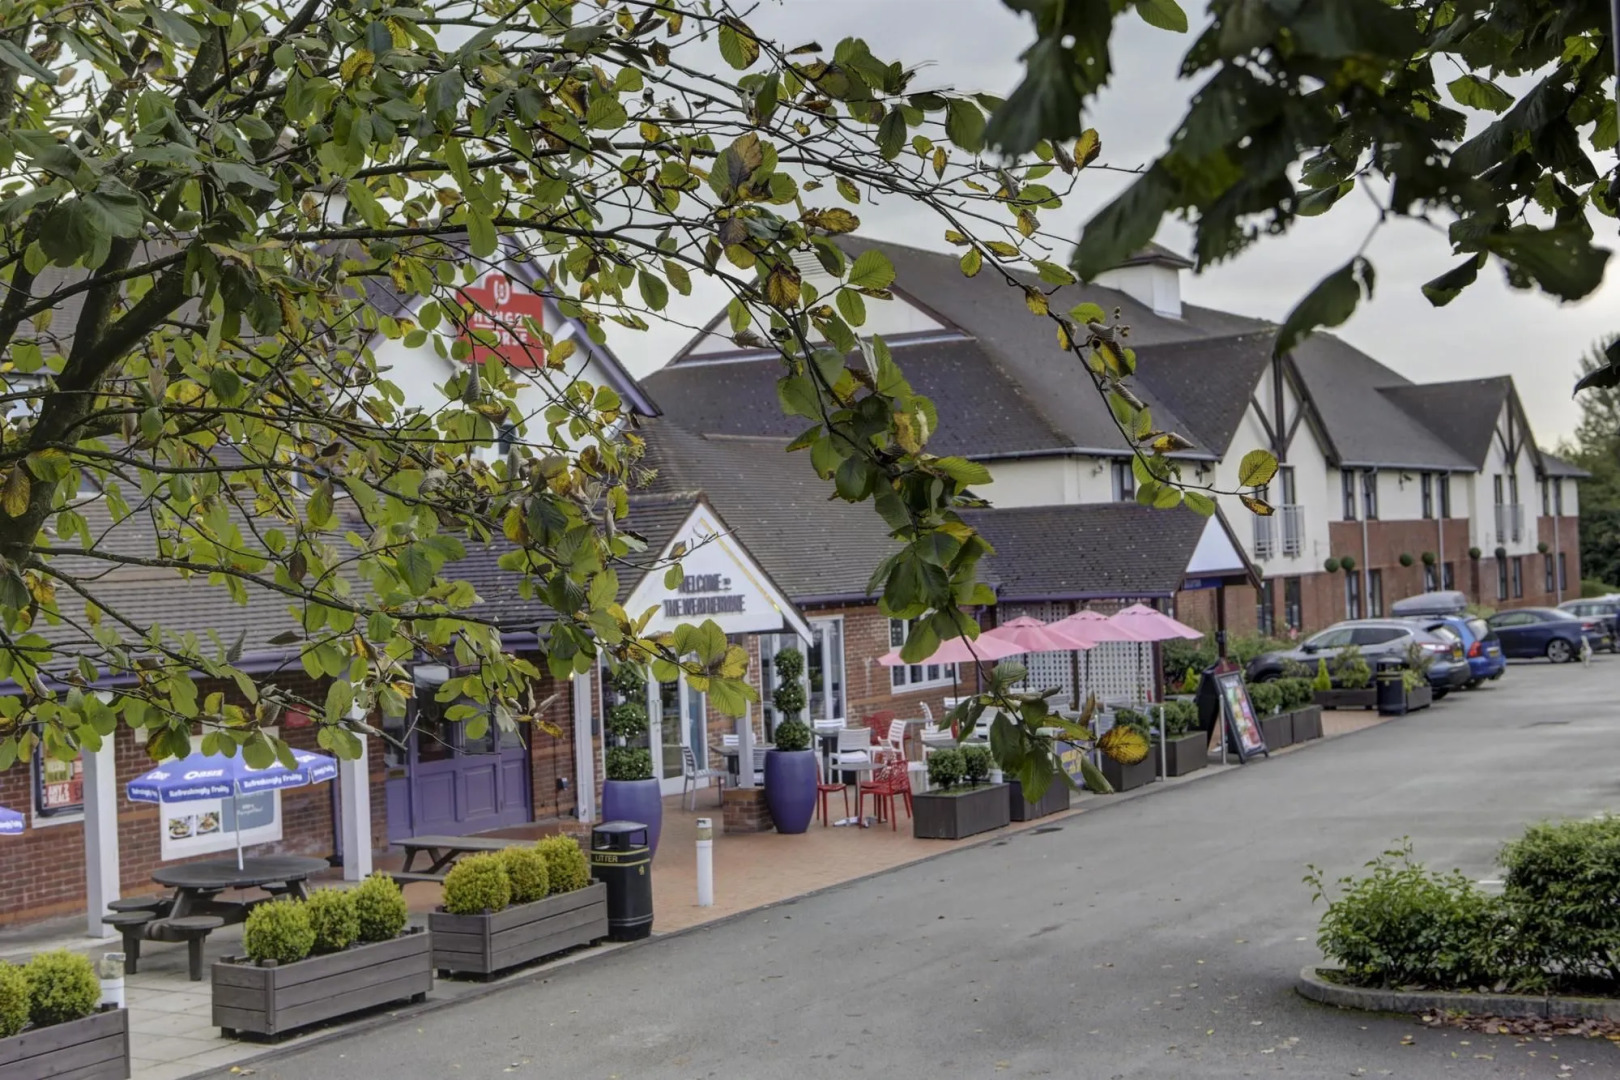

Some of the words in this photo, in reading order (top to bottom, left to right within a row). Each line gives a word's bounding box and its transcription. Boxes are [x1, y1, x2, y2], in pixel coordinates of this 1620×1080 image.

[474, 311, 532, 326] HUNGR
[663, 598, 682, 617] THE
[595, 855, 618, 863] LITTER
